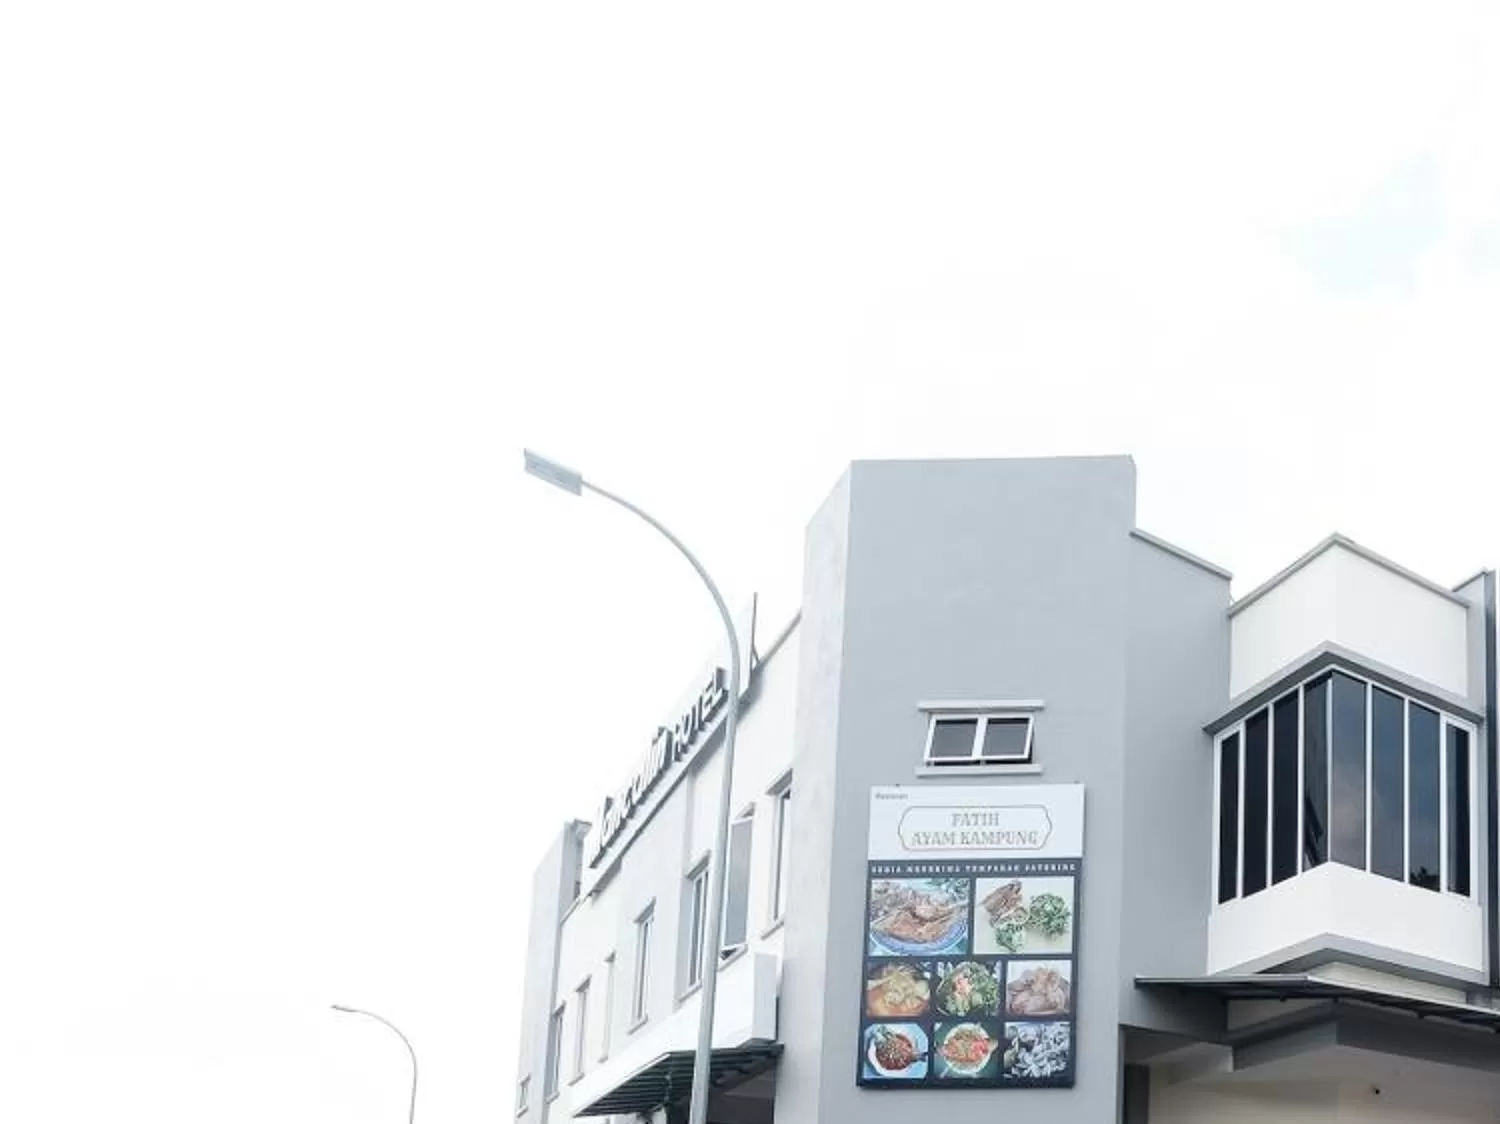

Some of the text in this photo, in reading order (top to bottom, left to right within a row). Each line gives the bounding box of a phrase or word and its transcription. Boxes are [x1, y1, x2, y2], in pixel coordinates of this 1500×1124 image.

[951, 812, 1000, 827] FATIH
[911, 830, 1039, 846] AYAM KAMPUNG
